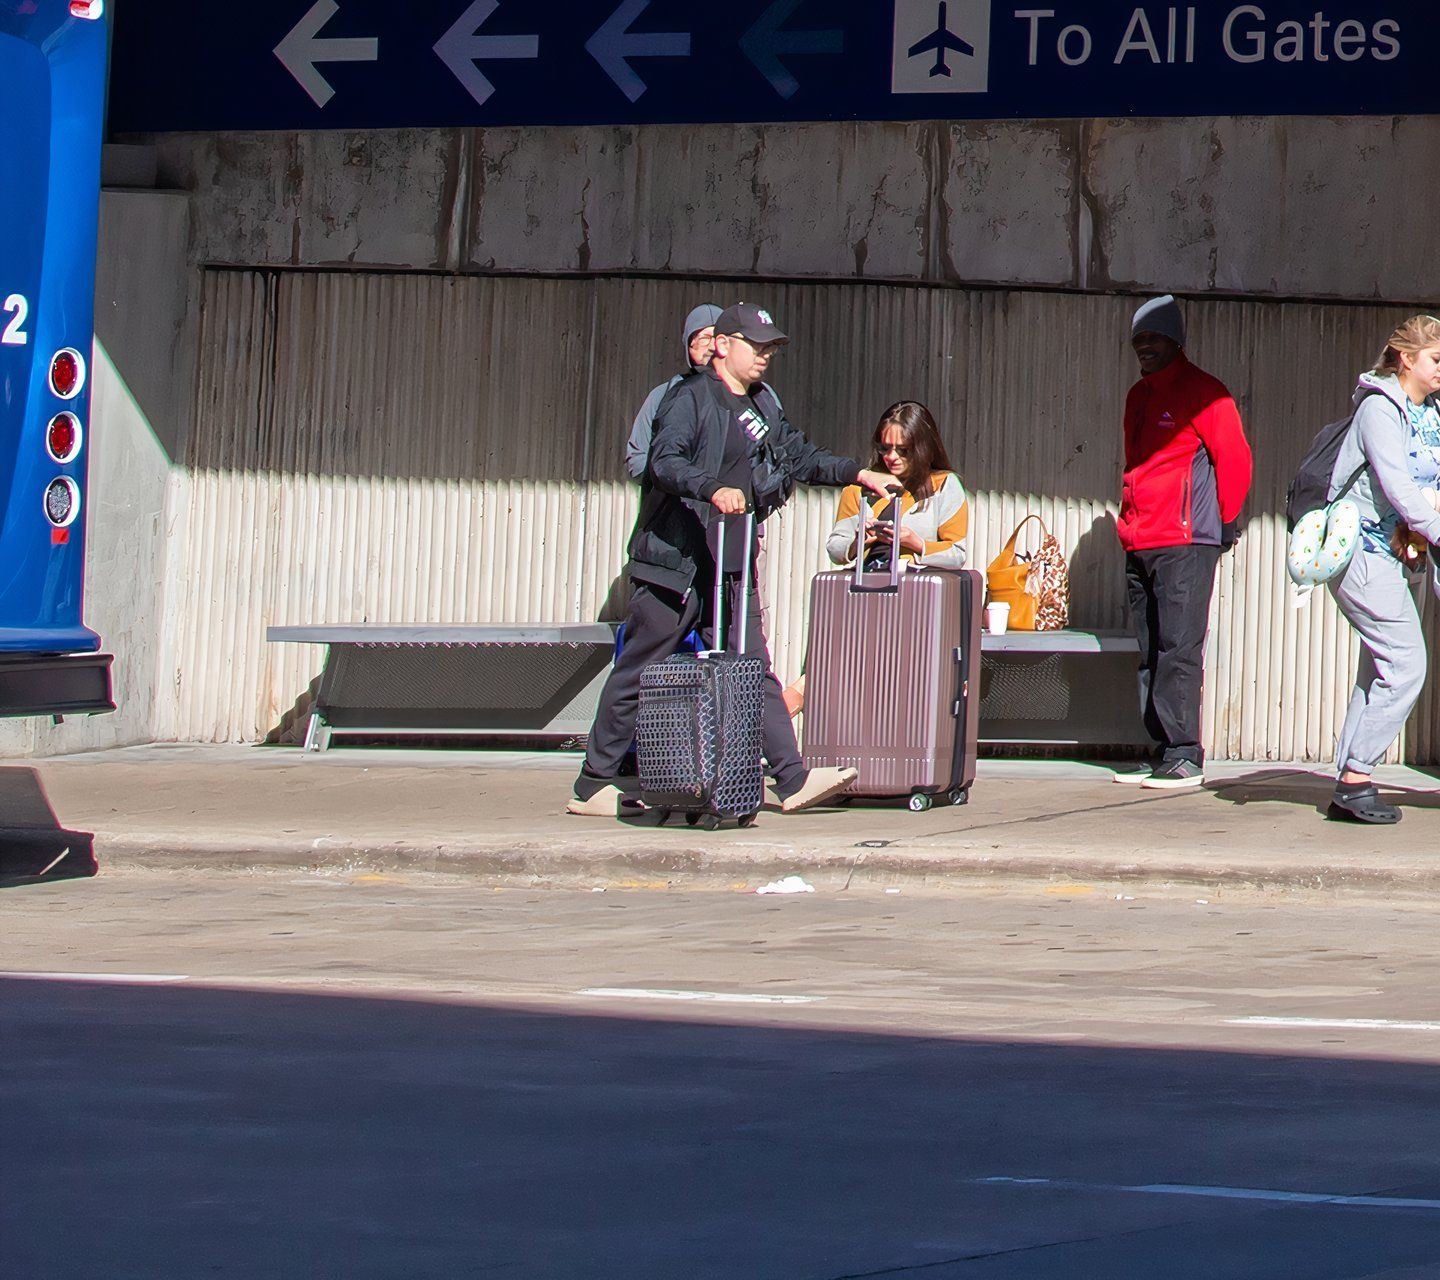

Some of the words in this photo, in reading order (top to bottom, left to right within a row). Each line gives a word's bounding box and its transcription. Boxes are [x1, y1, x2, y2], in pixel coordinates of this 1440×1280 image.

[1014, 9, 1092, 66] To
[1113, 7, 1196, 64] All
[1222, 4, 1401, 64] Gates
